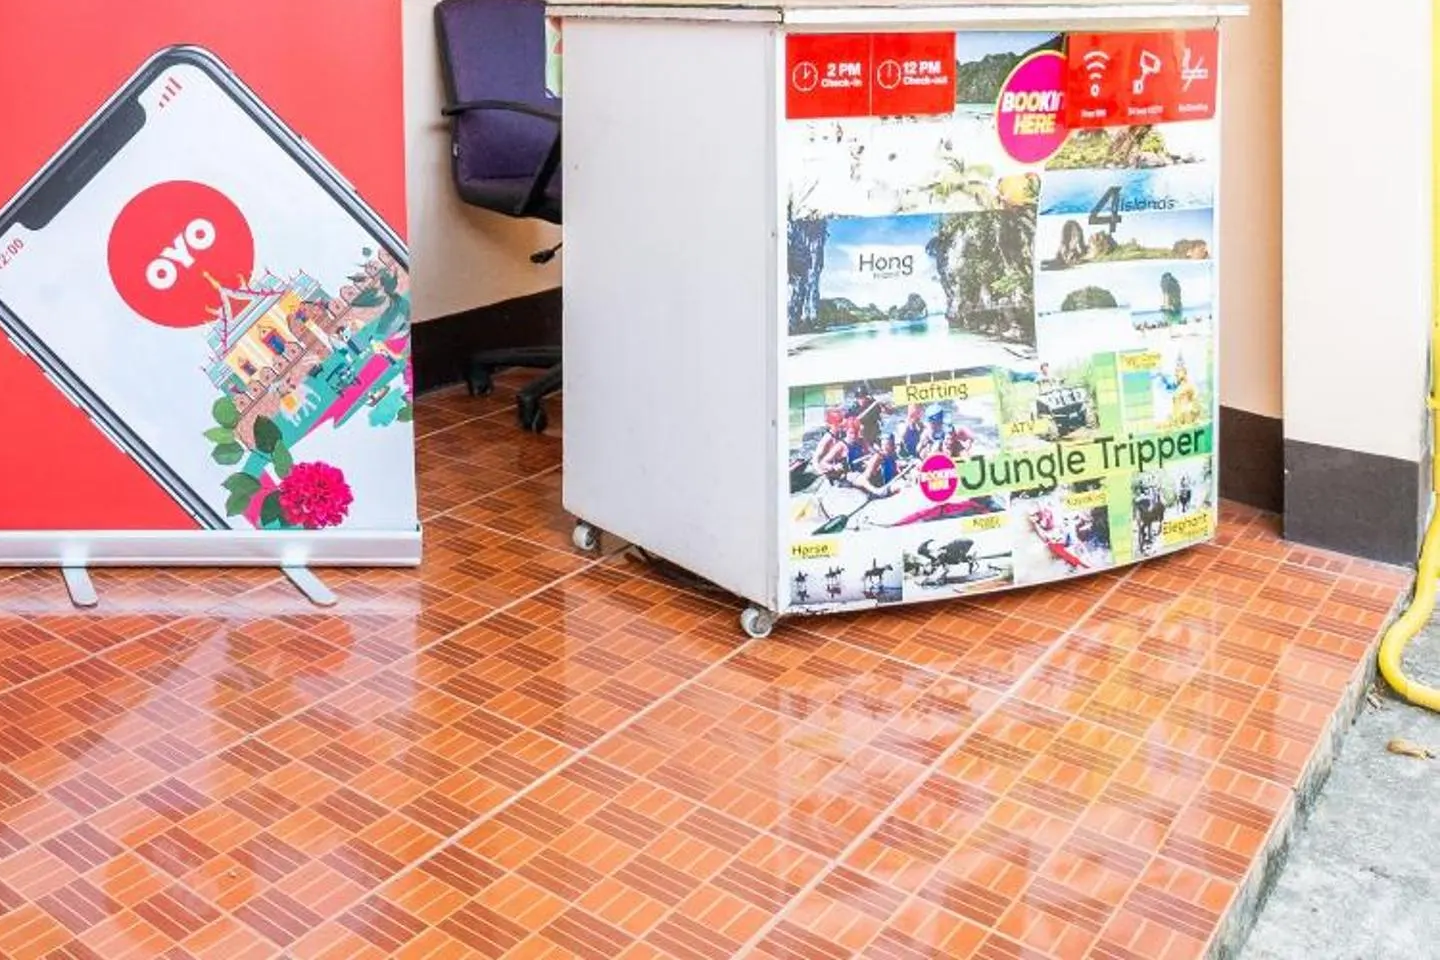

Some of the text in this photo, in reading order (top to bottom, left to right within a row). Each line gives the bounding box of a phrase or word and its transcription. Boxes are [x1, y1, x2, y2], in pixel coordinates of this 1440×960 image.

[826, 62, 862, 77] 2 PM
[902, 60, 942, 75] 12 PM
[1012, 113, 1057, 135] HERE
[1088, 186, 1123, 233] 4
[145, 217, 217, 291] OYO
[858, 252, 914, 276] Hong
[905, 382, 969, 401] Rafting
[1010, 420, 1036, 434] ATV
[960, 443, 1086, 490] Jungle
[1094, 428, 1206, 472] Tripper
[791, 543, 829, 557] Horse
